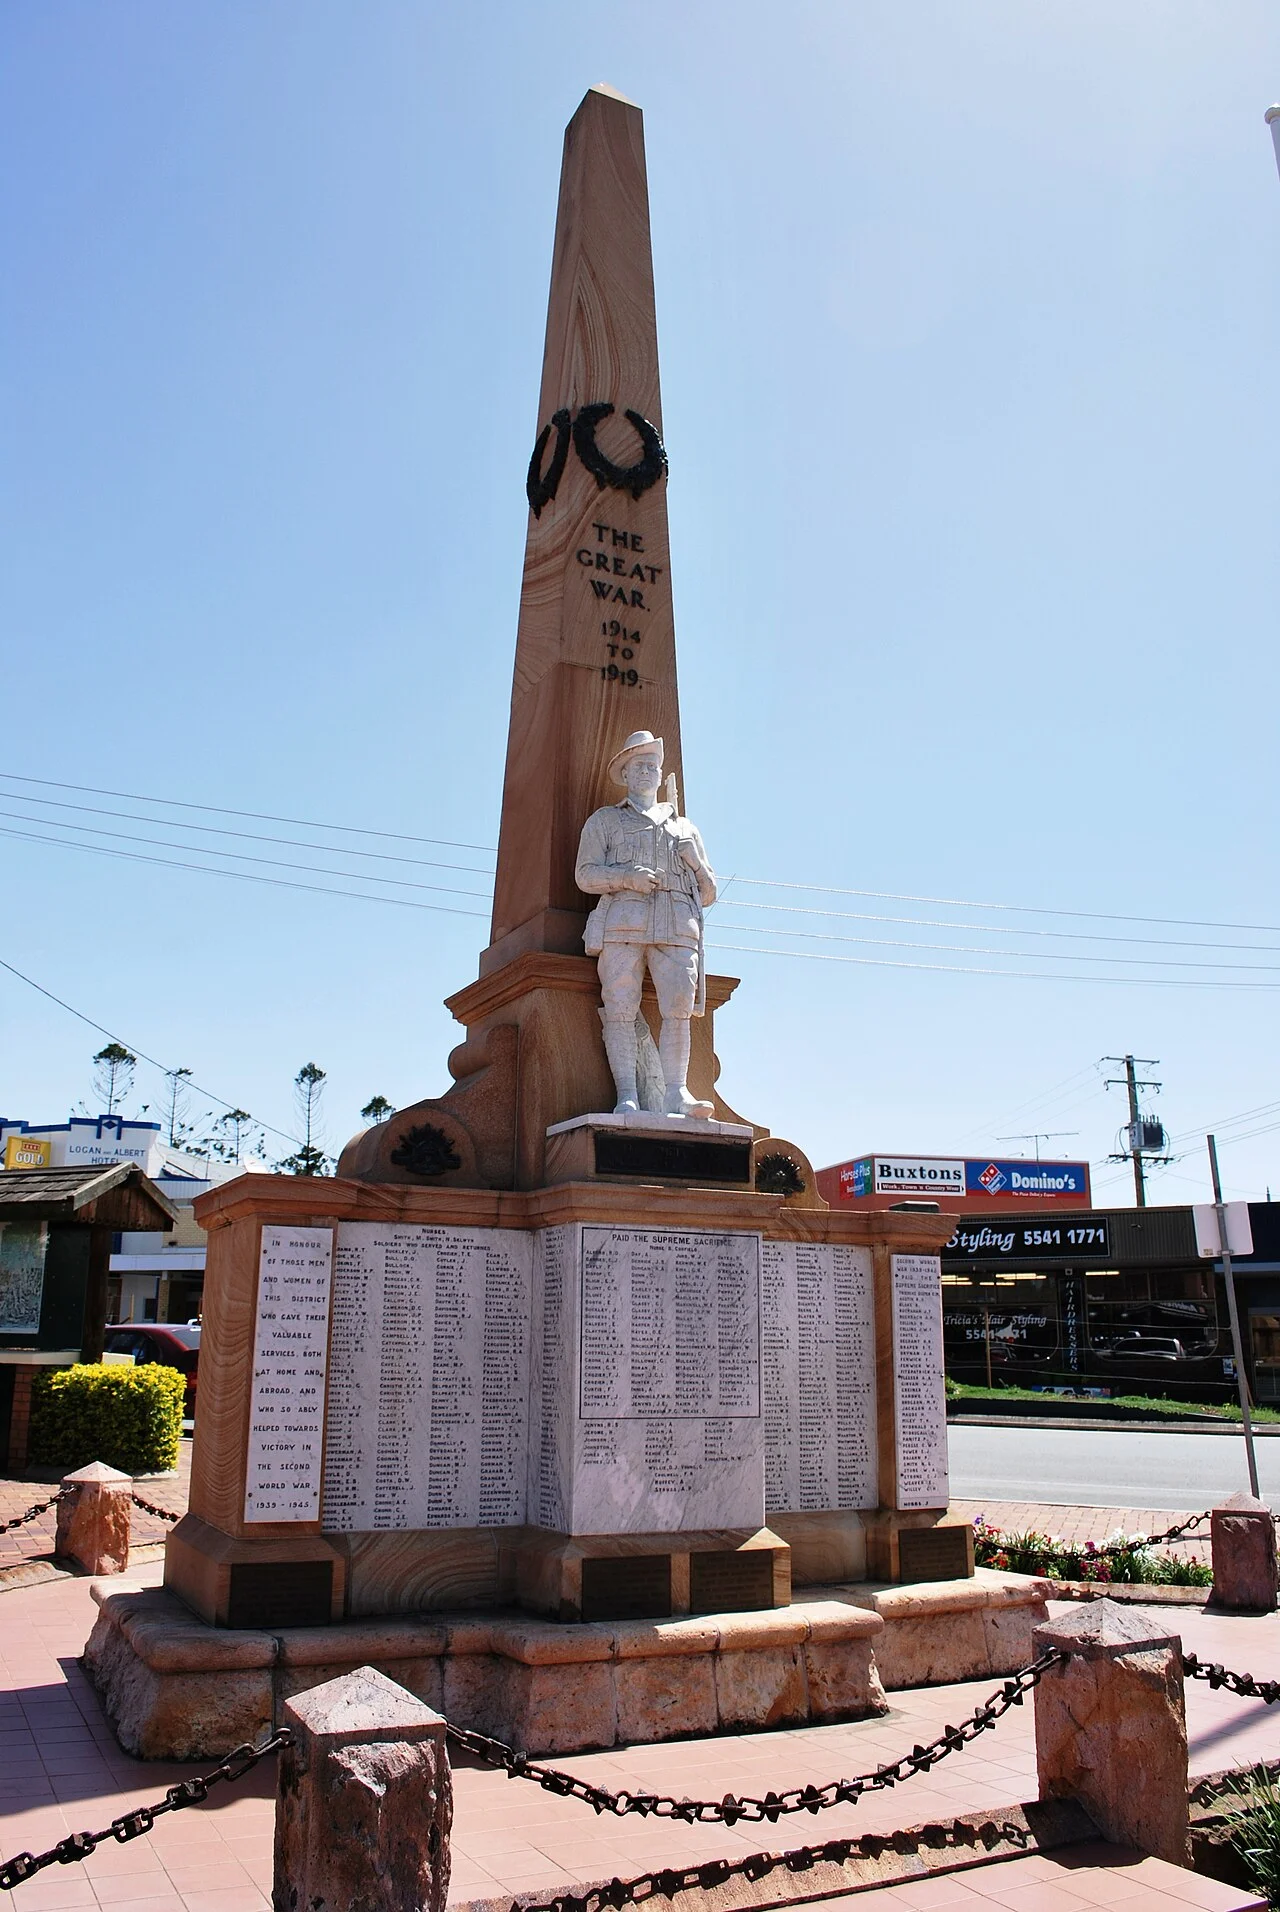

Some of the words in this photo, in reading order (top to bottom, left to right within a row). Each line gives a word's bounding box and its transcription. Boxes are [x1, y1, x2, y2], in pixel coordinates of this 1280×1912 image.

[592, 523, 644, 553] THE
[576, 549, 662, 584] GREAT
[590, 580, 650, 612] WAR.
[602, 620, 641, 643] 1914
[607, 644, 634, 660] TO
[602, 664, 642, 689] 1919.
[16, 1151, 44, 1165] GOLD
[70, 1145, 101, 1154] LOGAN
[879, 1164, 962, 1180] Buxtons
[1011, 1172, 1076, 1190] Domino's
[652, 1236, 690, 1245] SUPREME
[946, 1227, 1016, 1252] Styling
[1024, 1230, 1060, 1246] 5541
[1067, 1229, 1105, 1245] 1771
[944, 1315, 978, 1325] Tricia's
[1011, 1314, 1047, 1327] Styling
[1066, 1281, 1078, 1371] HAIRDRESSERS
